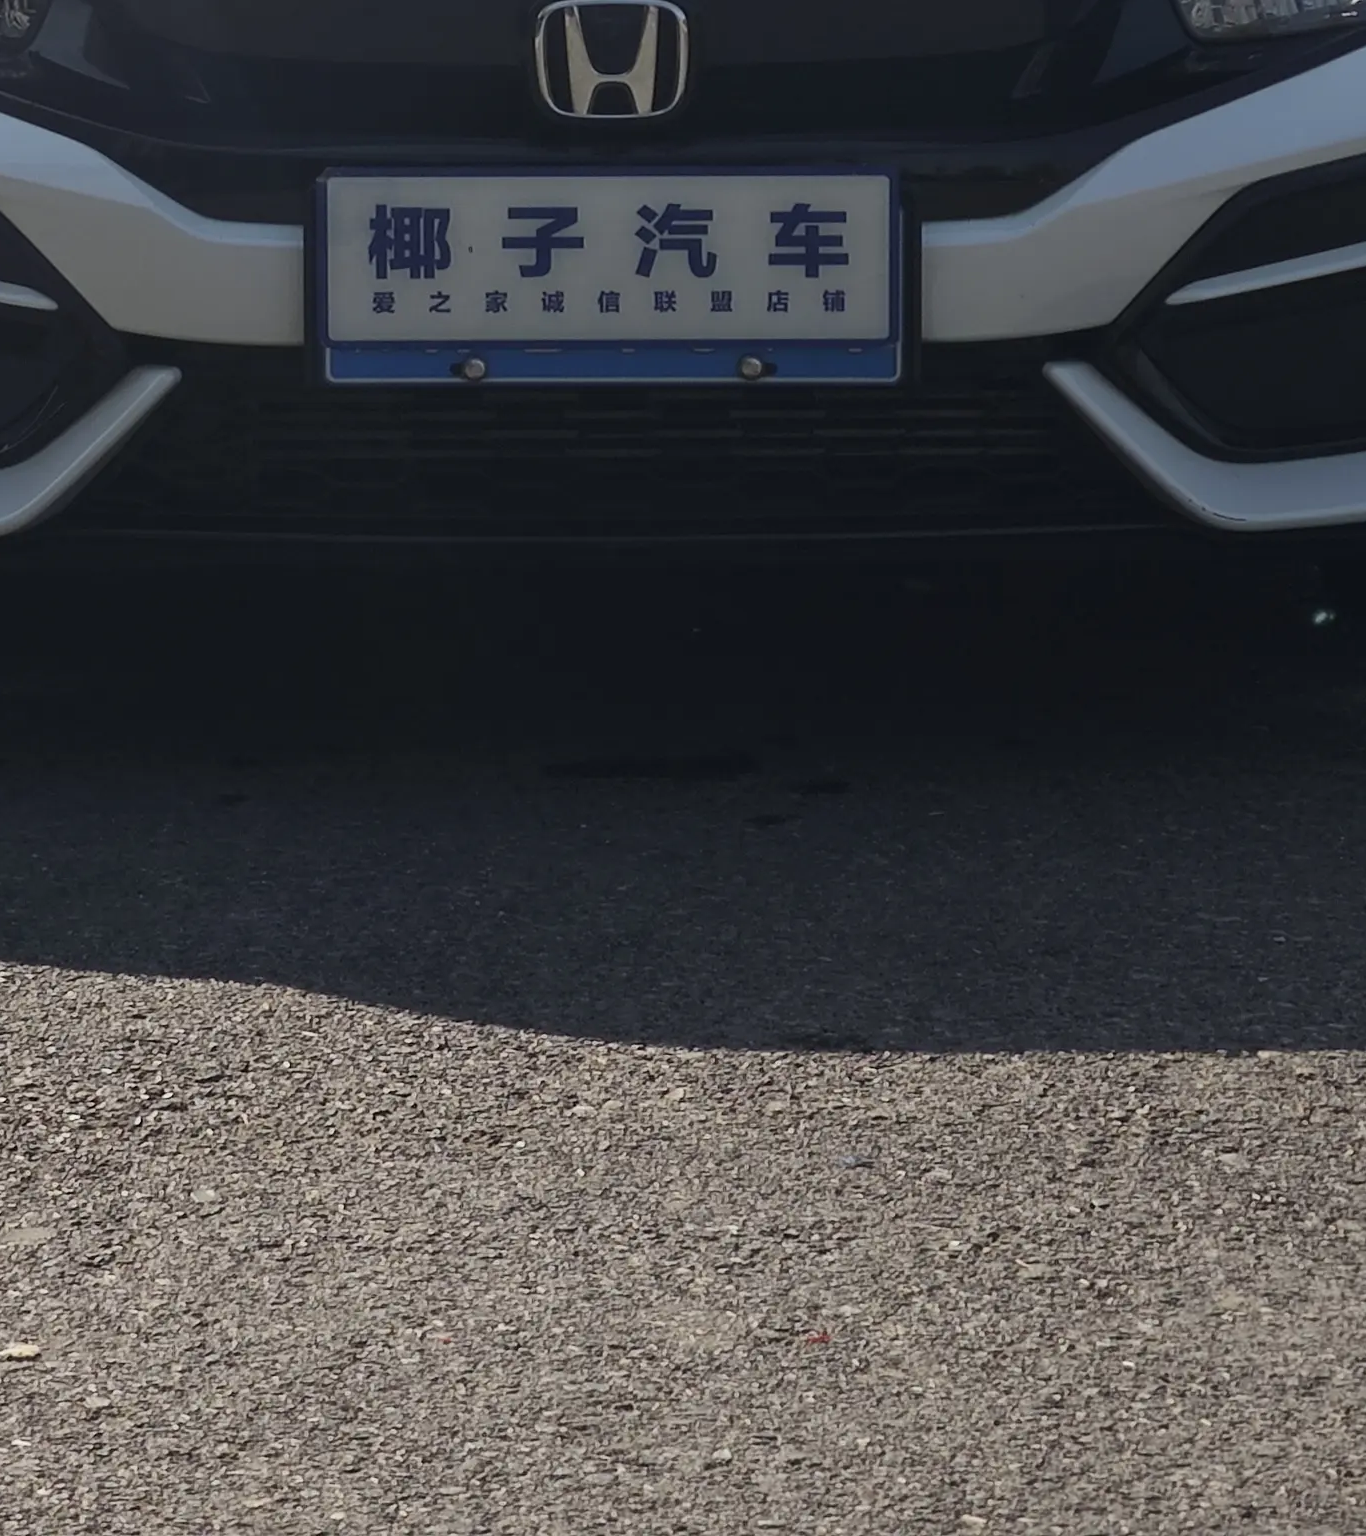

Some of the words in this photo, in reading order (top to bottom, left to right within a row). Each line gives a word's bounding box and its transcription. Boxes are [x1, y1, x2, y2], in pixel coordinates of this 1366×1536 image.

[368, 204, 850, 279] 椰子汽车
[371, 291, 847, 314] 爱之家诚信联盟店铺
